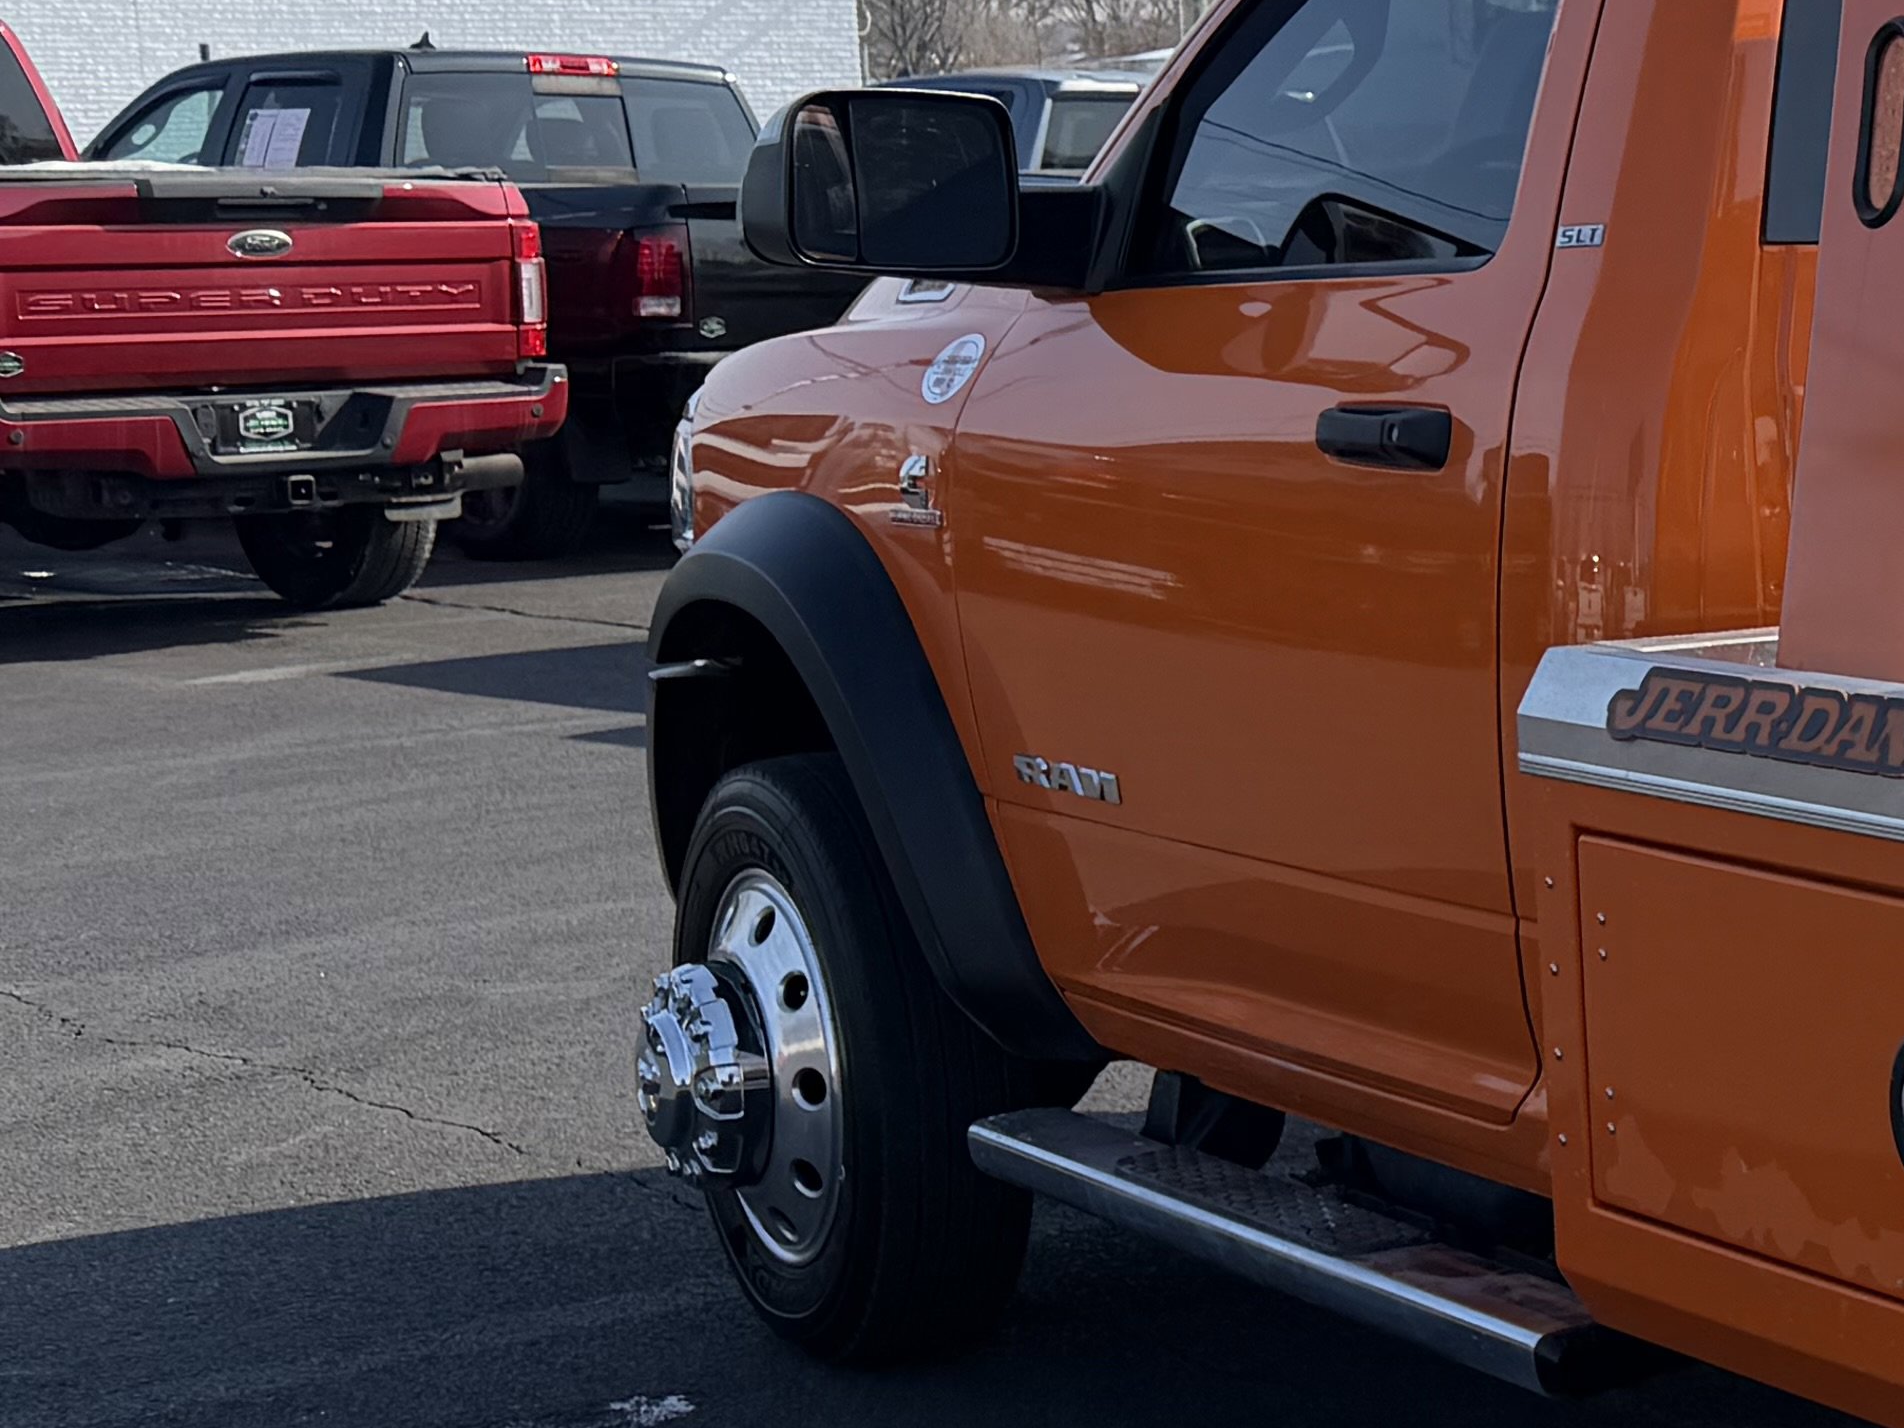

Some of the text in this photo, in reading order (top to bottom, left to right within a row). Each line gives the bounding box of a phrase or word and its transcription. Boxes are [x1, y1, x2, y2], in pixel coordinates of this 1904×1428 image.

[1559, 227, 1601, 244] SLT
[25, 283, 475, 312] SUPER DUTY
[1013, 754, 1122, 805] RAM
